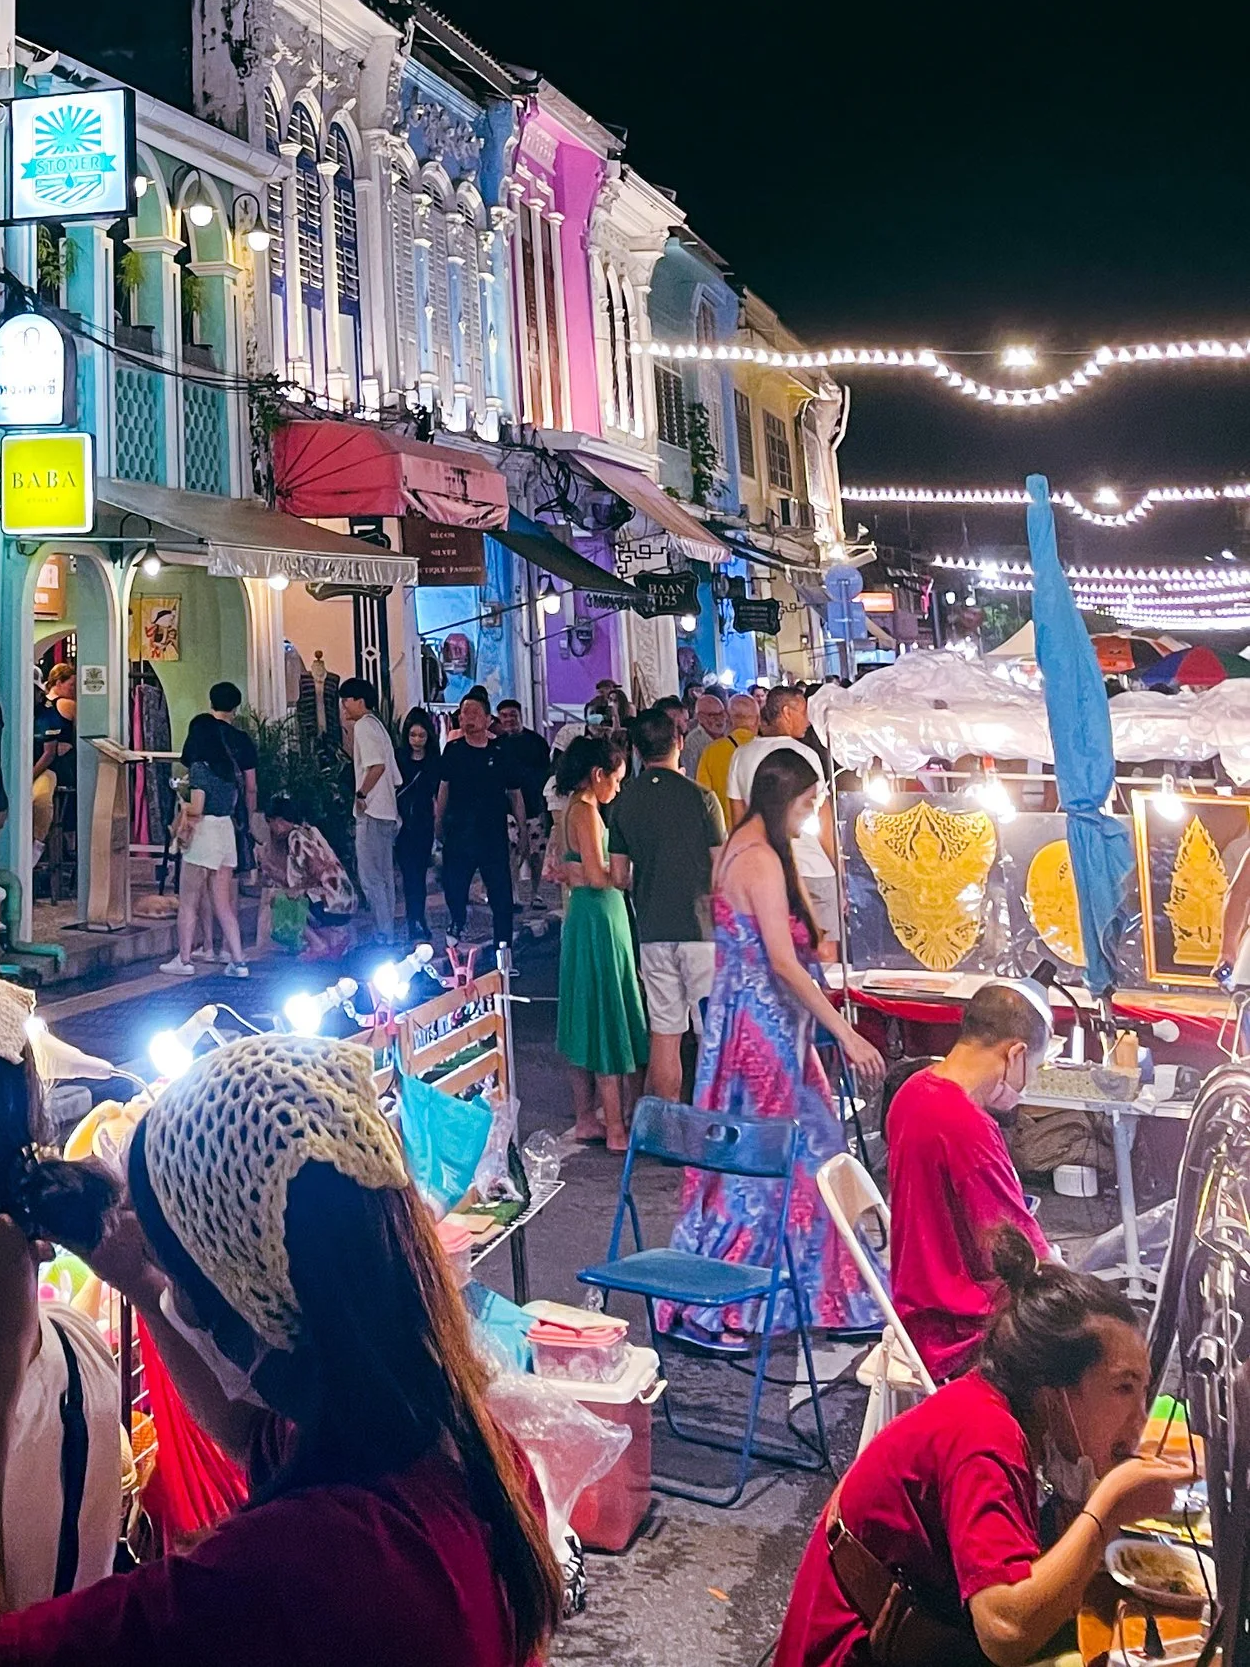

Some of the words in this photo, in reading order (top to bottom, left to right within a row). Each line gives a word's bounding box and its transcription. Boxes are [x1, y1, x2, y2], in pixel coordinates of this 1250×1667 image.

[36, 156, 100, 174] STONER
[12, 471, 77, 490] BABA
[430, 548, 458, 556] SILVER
[648, 583, 686, 595] BAAN
[659, 595, 678, 607] 125
